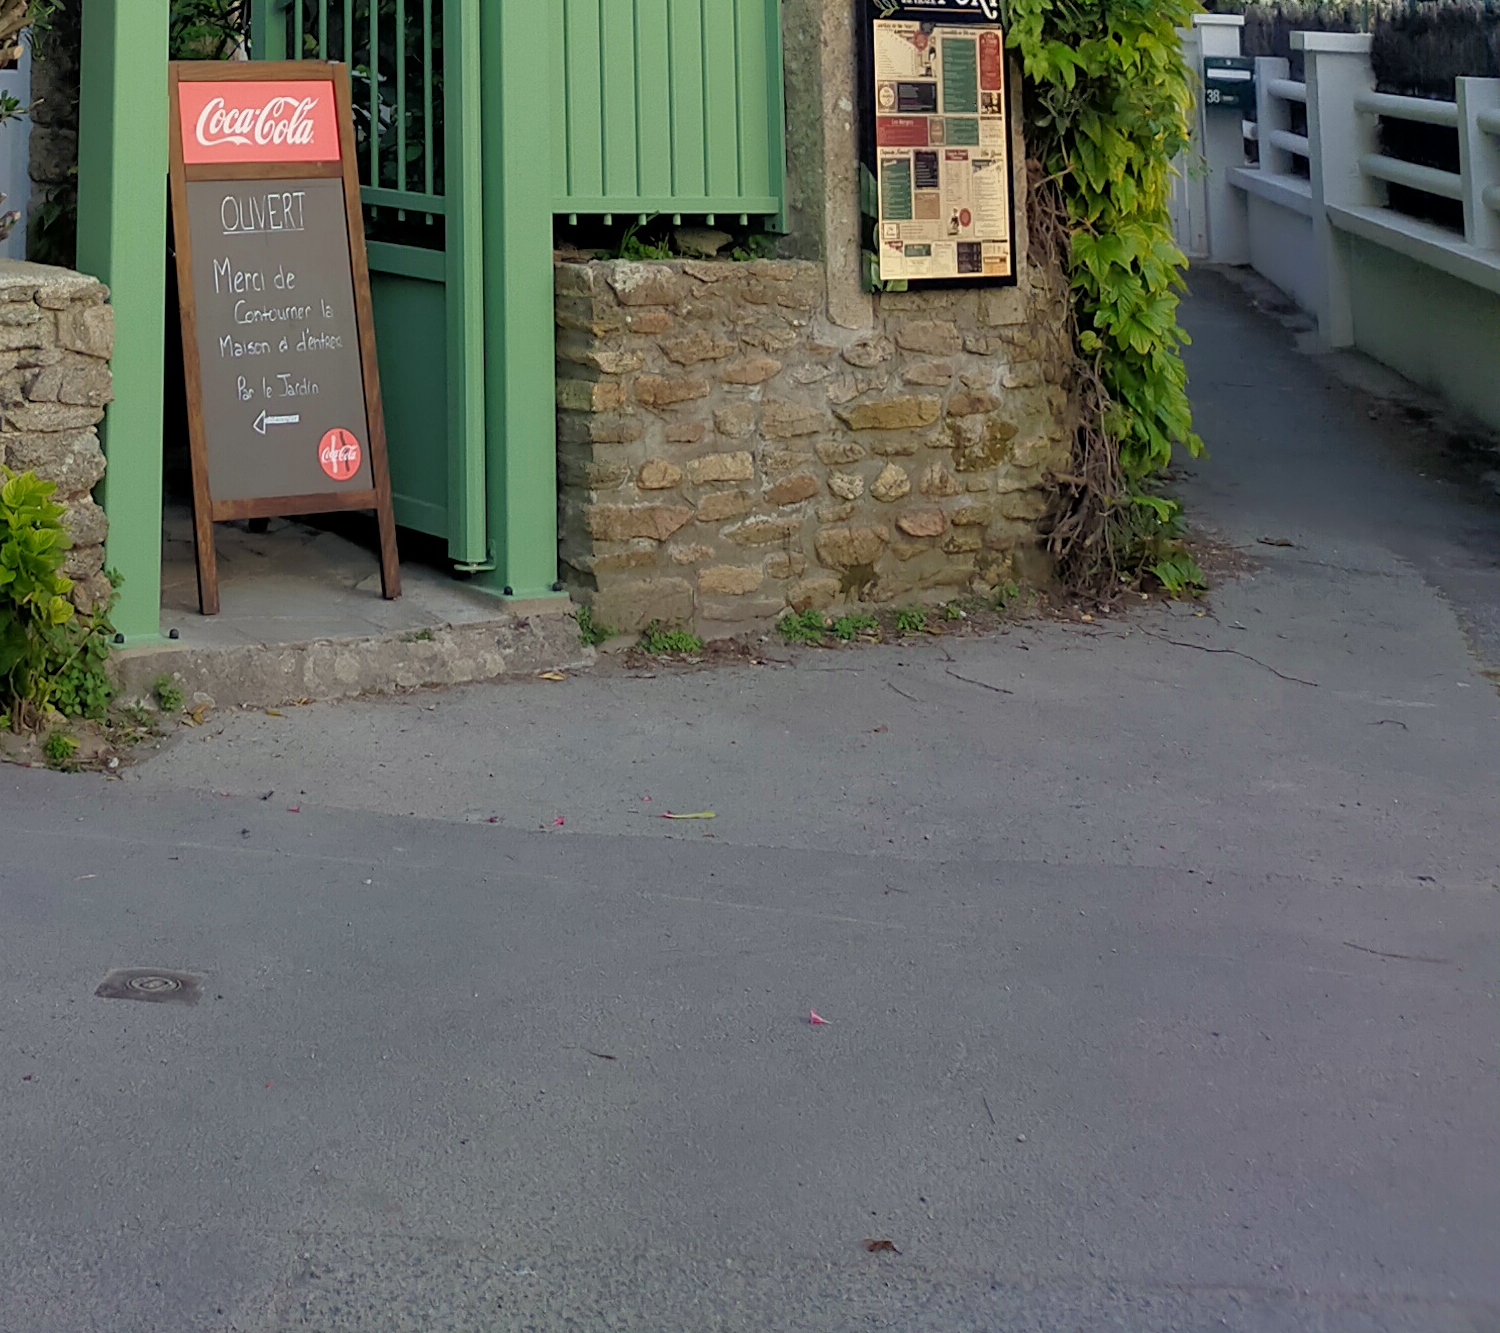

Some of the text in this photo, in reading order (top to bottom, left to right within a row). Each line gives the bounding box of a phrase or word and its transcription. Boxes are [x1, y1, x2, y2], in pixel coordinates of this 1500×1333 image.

[1206, 89, 1220, 103] 38
[196, 97, 319, 146] Coca-Cola
[221, 192, 306, 231] OUVERT
[213, 257, 295, 294] Merci de
[234, 298, 334, 324] Contourner la
[219, 334, 271, 357] Maison
[237, 373, 319, 401] Par le Jardin
